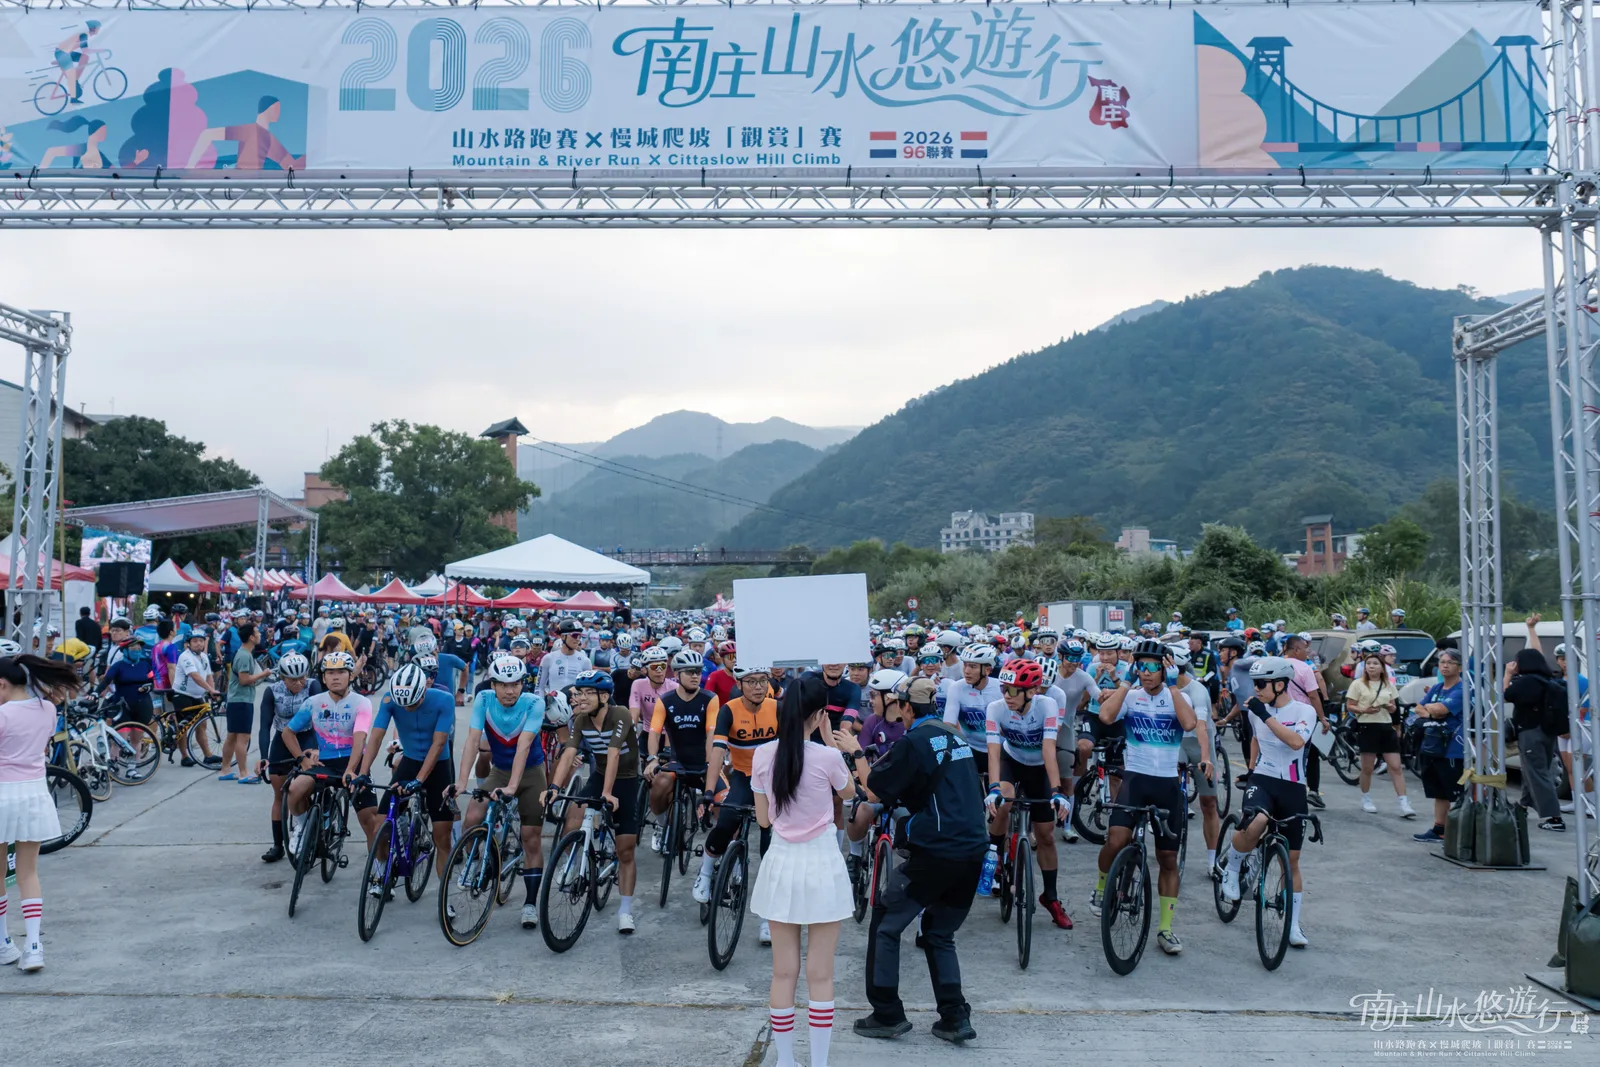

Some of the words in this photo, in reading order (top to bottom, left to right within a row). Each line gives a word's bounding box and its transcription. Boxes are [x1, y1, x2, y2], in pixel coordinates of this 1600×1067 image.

[339, 17, 592, 112] 2026
[612, 6, 1103, 117] 南庄山水悠遊行
[1100, 85, 1123, 121] 南庄
[903, 131, 953, 144] 2026
[903, 145, 954, 159] 96聯賽
[453, 154, 531, 167] Mountain
[538, 154, 549, 166] &
[557, 153, 602, 166] River
[608, 153, 640, 166] Run
[668, 152, 749, 165] Cittaslow
[756, 152, 785, 165] Hill
[792, 152, 841, 165] Climb
[501, 665, 518, 673] 429
[1000, 672, 1013, 682] 404
[394, 689, 410, 697] 420
[1131, 726, 1176, 737] WAYPOINT
